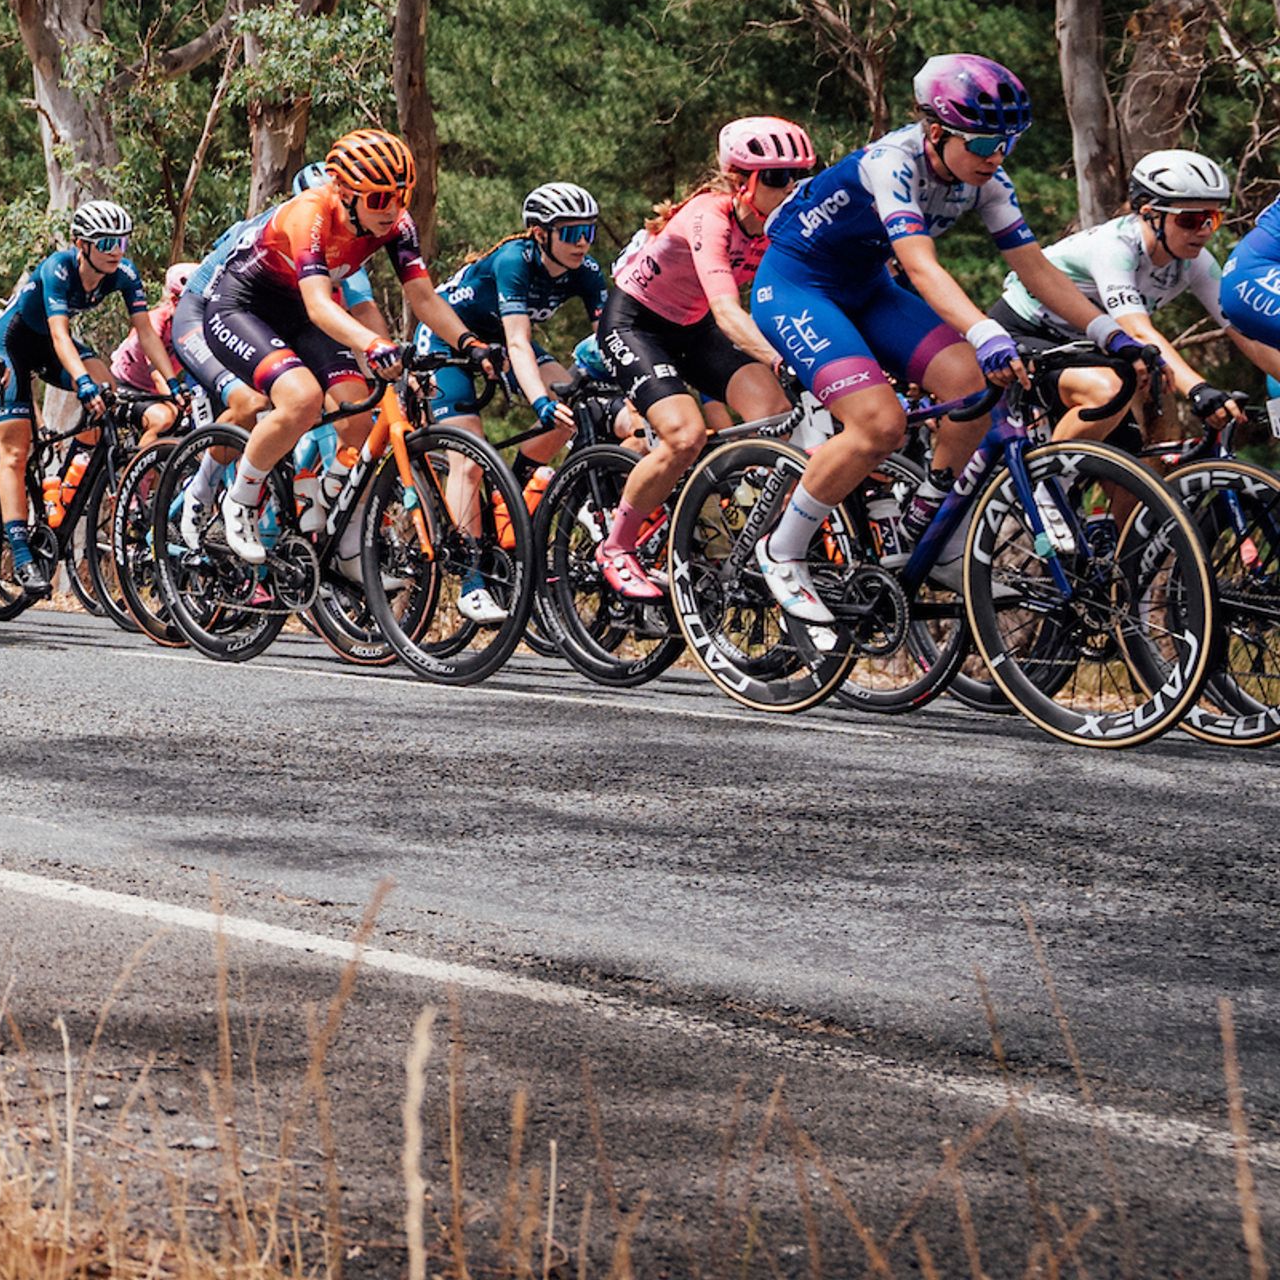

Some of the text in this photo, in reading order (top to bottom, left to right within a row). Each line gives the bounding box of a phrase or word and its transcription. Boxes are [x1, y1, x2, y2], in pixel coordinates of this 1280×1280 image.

[893, 162, 914, 204] Liv
[798, 189, 851, 238] Jayco
[207, 313, 257, 361] THORNE
[772, 314, 816, 370] ALULA
[819, 371, 870, 401] CADEX
[953, 450, 986, 496] Liv
[673, 550, 751, 693] CADEX
[349, 645, 384, 656] AEOLUS
[1074, 628, 1199, 737] CADEX
